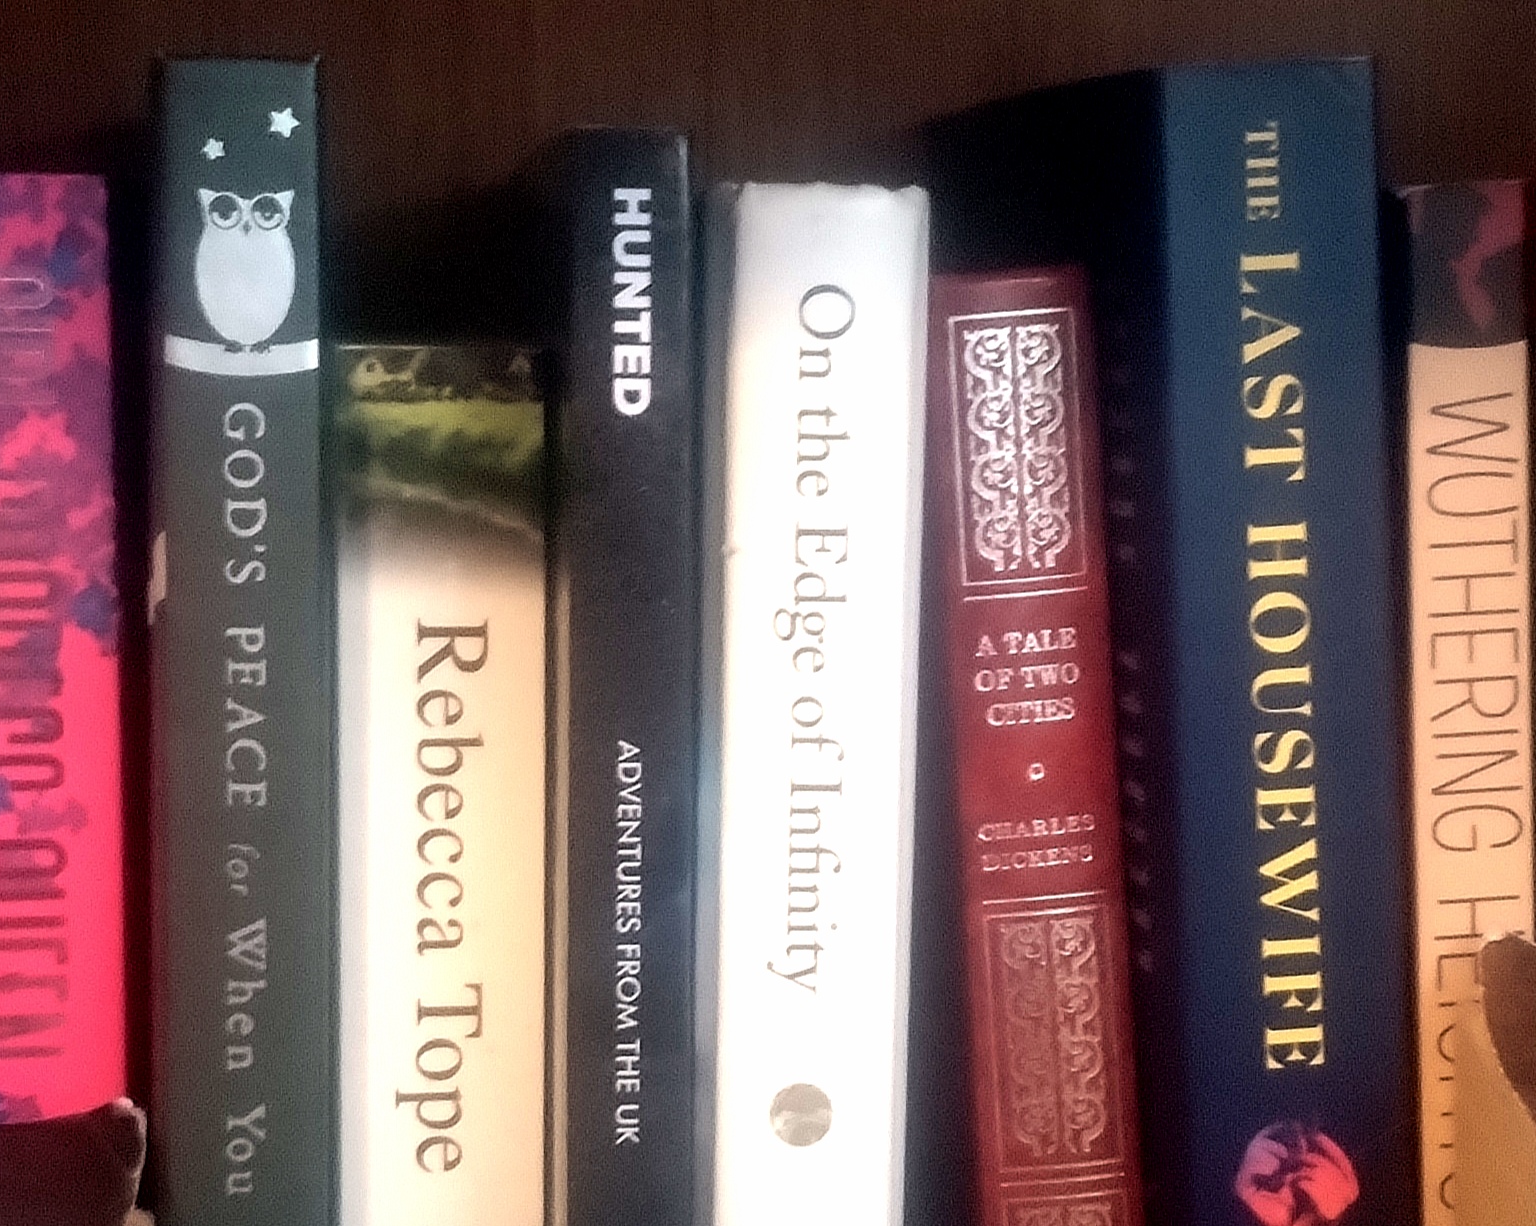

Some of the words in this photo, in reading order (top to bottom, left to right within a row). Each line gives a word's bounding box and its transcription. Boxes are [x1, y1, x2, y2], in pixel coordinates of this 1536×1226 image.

[1244, 121, 1281, 222] THE
[613, 187, 652, 418] HUNTED
[799, 283, 856, 381] On
[1239, 251, 1306, 481] LAST
[223, 402, 267, 584] GOD'S
[795, 406, 851, 498] the
[773, 522, 848, 673] Edge
[975, 634, 998, 657] A
[1003, 627, 1077, 655] TALE
[1427, 391, 1524, 852] WUTHERING
[224, 625, 266, 808] PEACE
[974, 667, 1015, 692] OF
[1020, 662, 1080, 688] TWO
[986, 697, 1076, 726] CITIES
[791, 695, 845, 762] of
[416, 617, 489, 956] Rebecca
[978, 813, 1095, 842] CHARLES
[1247, 522, 1326, 1070] HOUSEWIFE
[226, 843, 261, 896] for
[614, 740, 642, 934] ADVENTURES
[766, 776, 843, 994] Infinity
[981, 843, 1094, 872] DICKENS
[225, 917, 267, 1071] When
[614, 944, 642, 1031] FROM
[395, 981, 483, 1174] Tope
[614, 1037, 641, 1094] THE
[225, 1102, 267, 1196] You
[614, 1103, 641, 1146] UK
